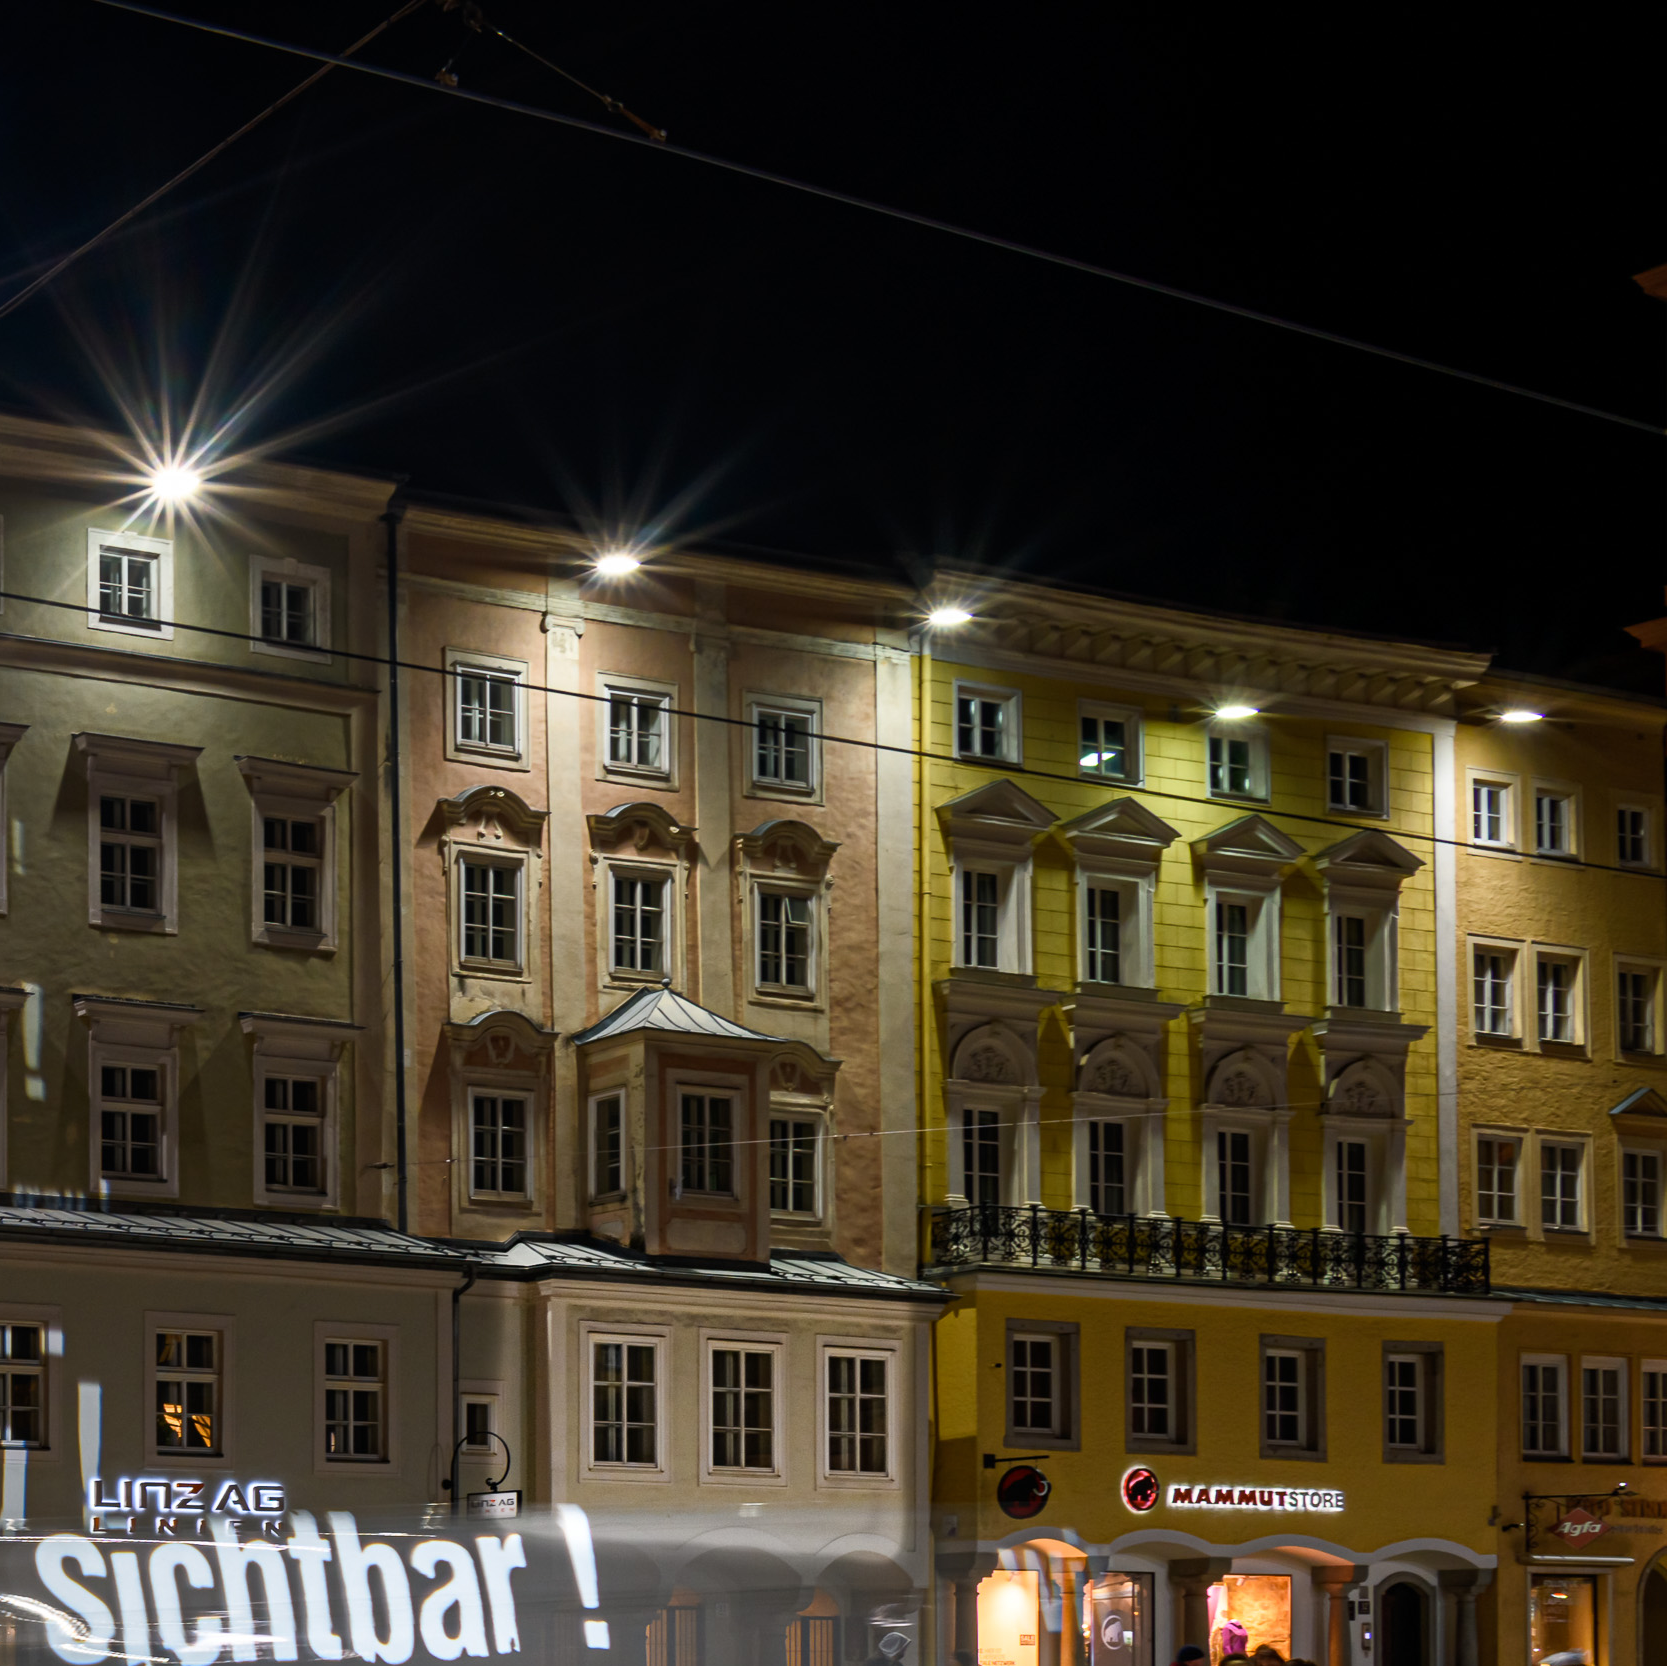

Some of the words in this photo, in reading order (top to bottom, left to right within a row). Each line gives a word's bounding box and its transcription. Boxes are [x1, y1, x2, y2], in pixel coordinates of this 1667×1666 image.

[213, 1482, 286, 1513] AG
[498, 1498, 515, 1506] AG
[1557, 1520, 1603, 1537] Agfa
